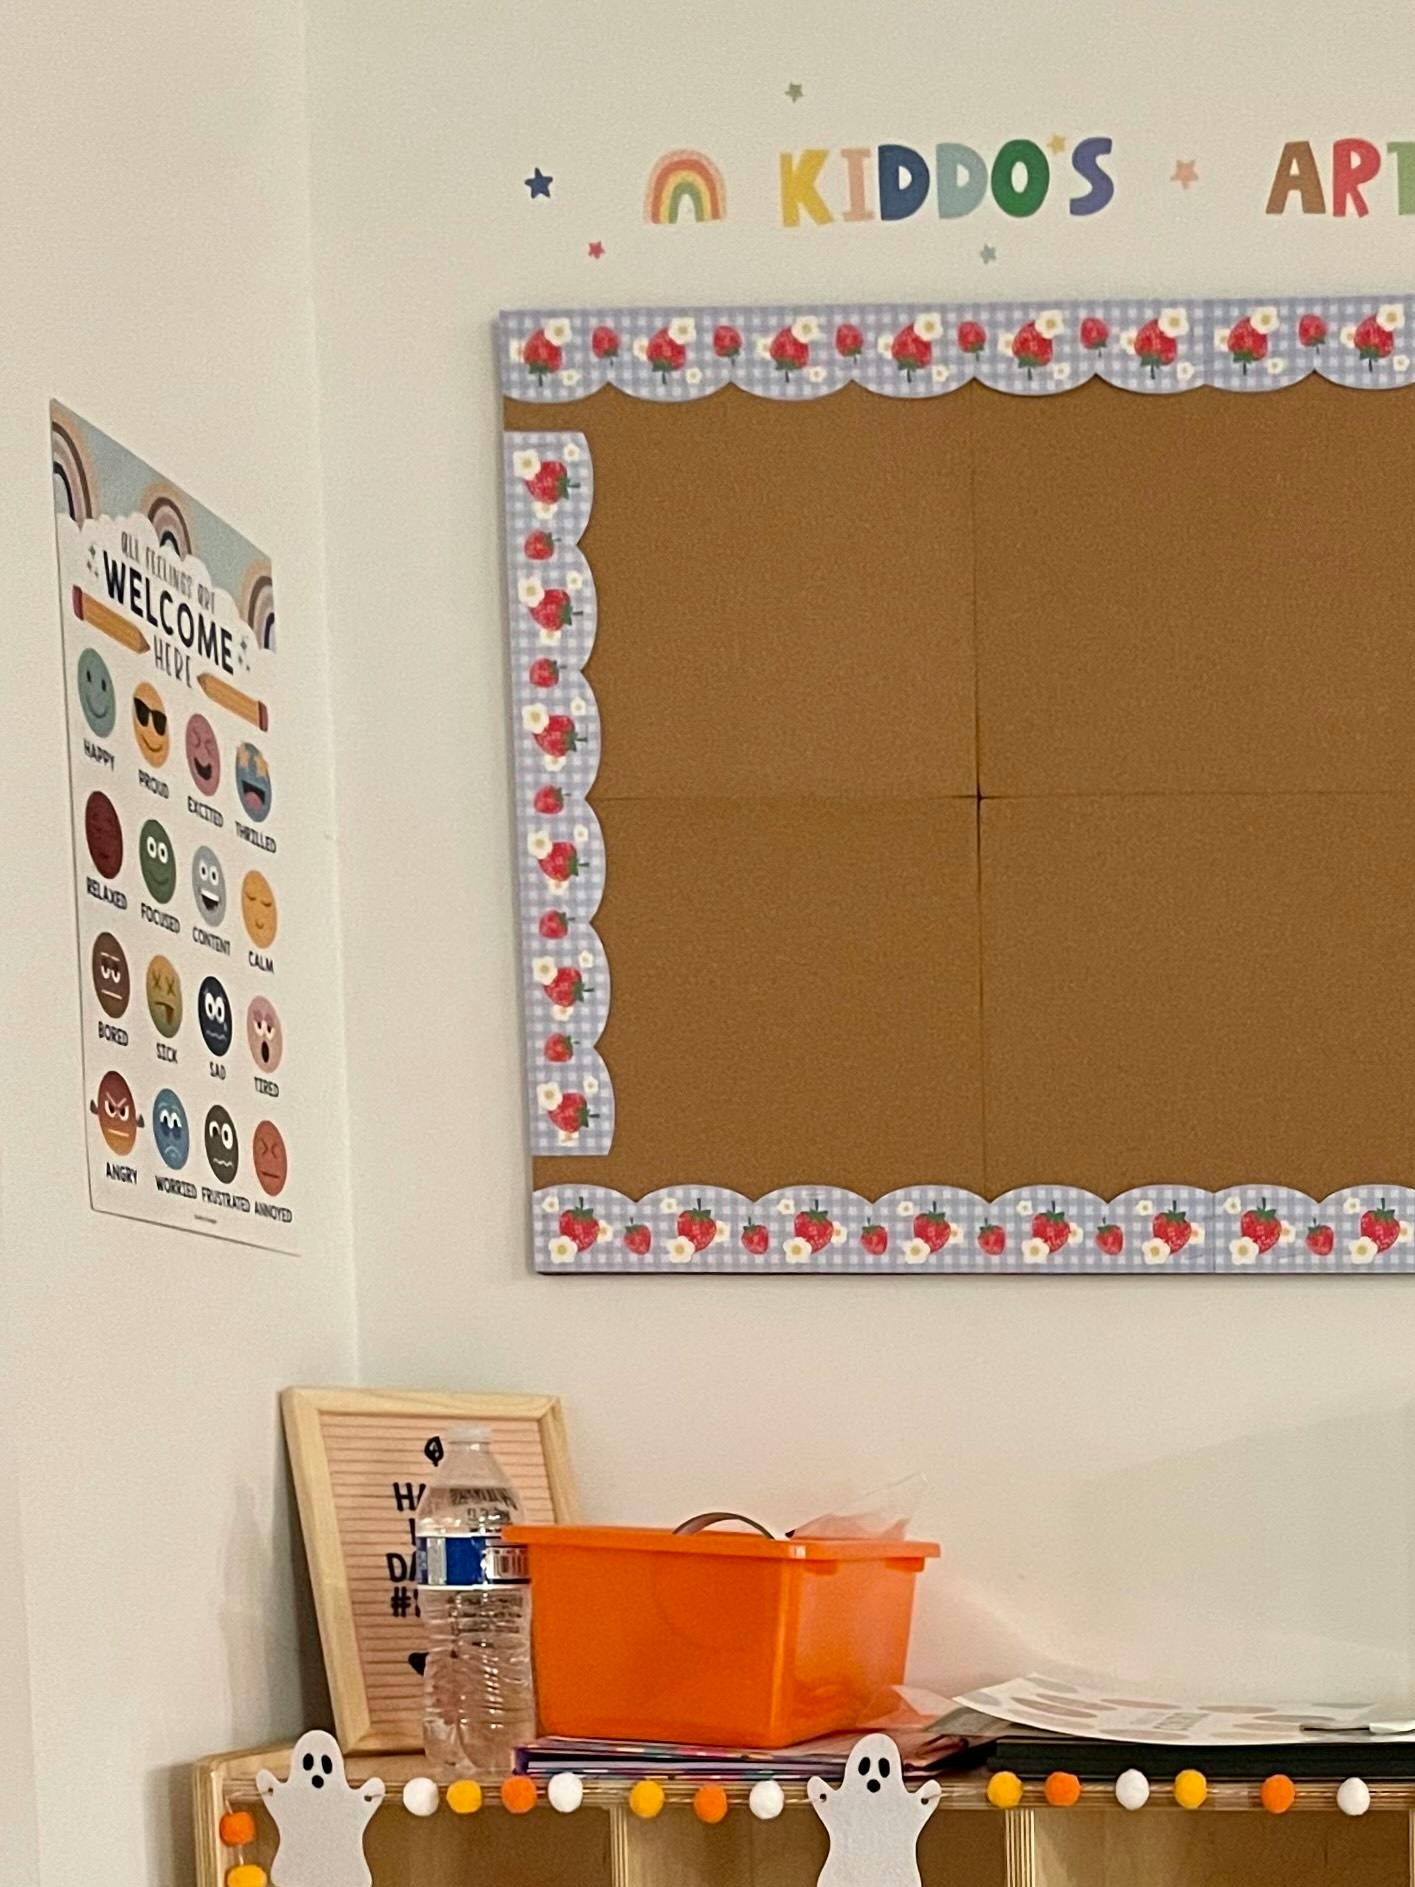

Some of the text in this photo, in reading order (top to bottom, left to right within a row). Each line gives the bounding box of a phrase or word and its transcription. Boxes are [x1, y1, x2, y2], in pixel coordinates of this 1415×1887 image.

[146, 546, 193, 600] FEELINGS
[103, 549, 234, 676] WELCOME
[153, 634, 192, 688] HERE
[83, 738, 115, 772] HAPPY
[139, 769, 170, 800] PROUD
[187, 796, 224, 828] EXCITED
[235, 821, 277, 853] THRILLED
[87, 876, 127, 910] RELAXED
[141, 902, 180, 934] FOCUSED
[192, 927, 231, 955] CONTENT
[248, 951, 274, 974] CALM
[98, 1021, 128, 1047] BORED
[156, 1043, 178, 1065] SICK
[210, 1061, 226, 1081] SAD
[254, 1076, 279, 1098] TIRED
[106, 1162, 138, 1185] ANGRY
[155, 1175, 197, 1199] WORRIED
[201, 1186, 250, 1213] FRUSTRATED
[254, 1201, 292, 1223] ANNOYED
